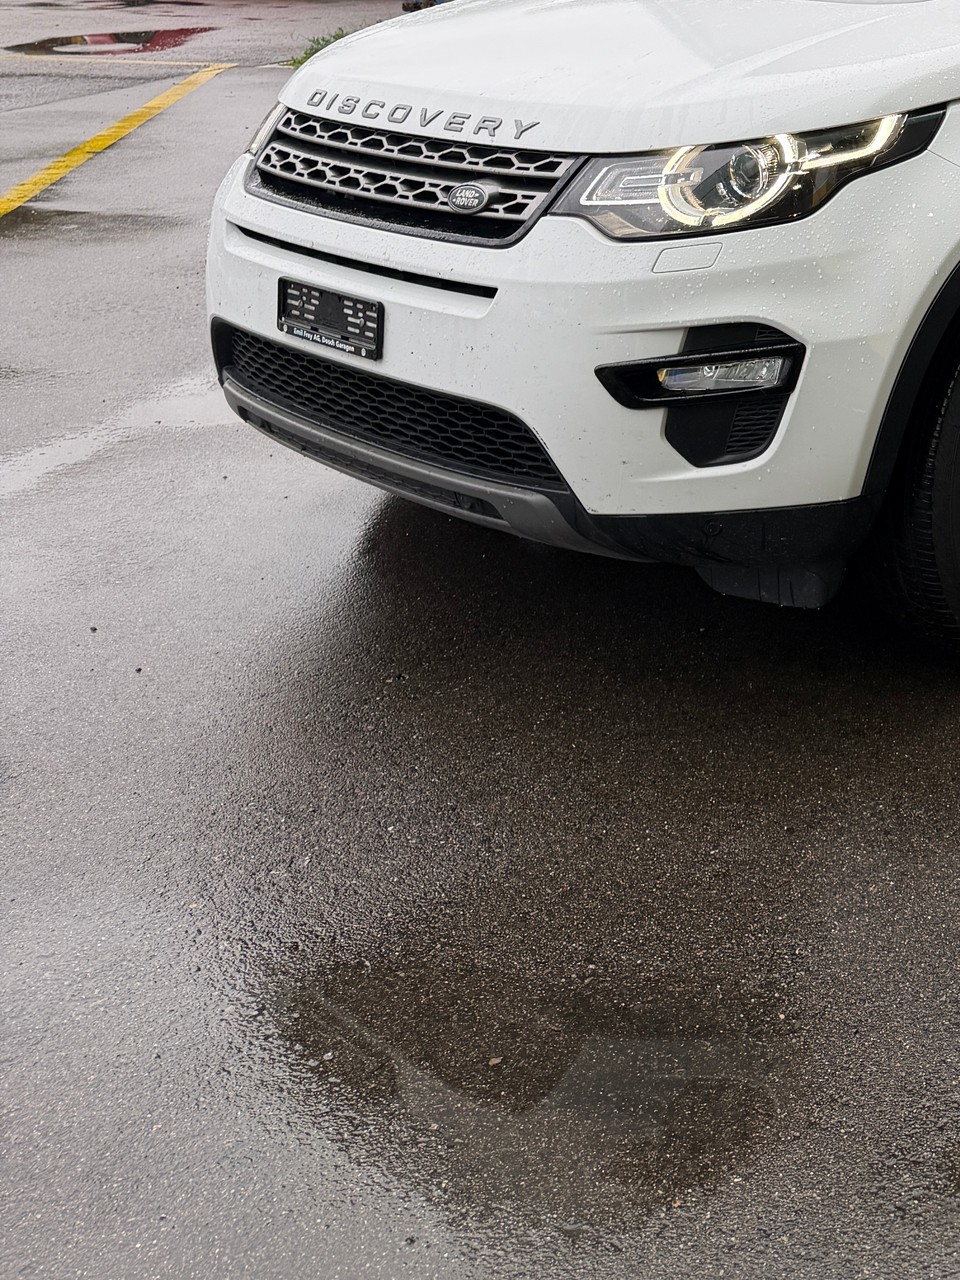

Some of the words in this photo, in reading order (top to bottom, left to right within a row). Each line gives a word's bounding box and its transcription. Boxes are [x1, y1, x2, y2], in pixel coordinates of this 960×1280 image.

[306, 88, 541, 140] DISCOVERY
[293, 327, 303, 336] Emil
[304, 331, 313, 341] Frey
